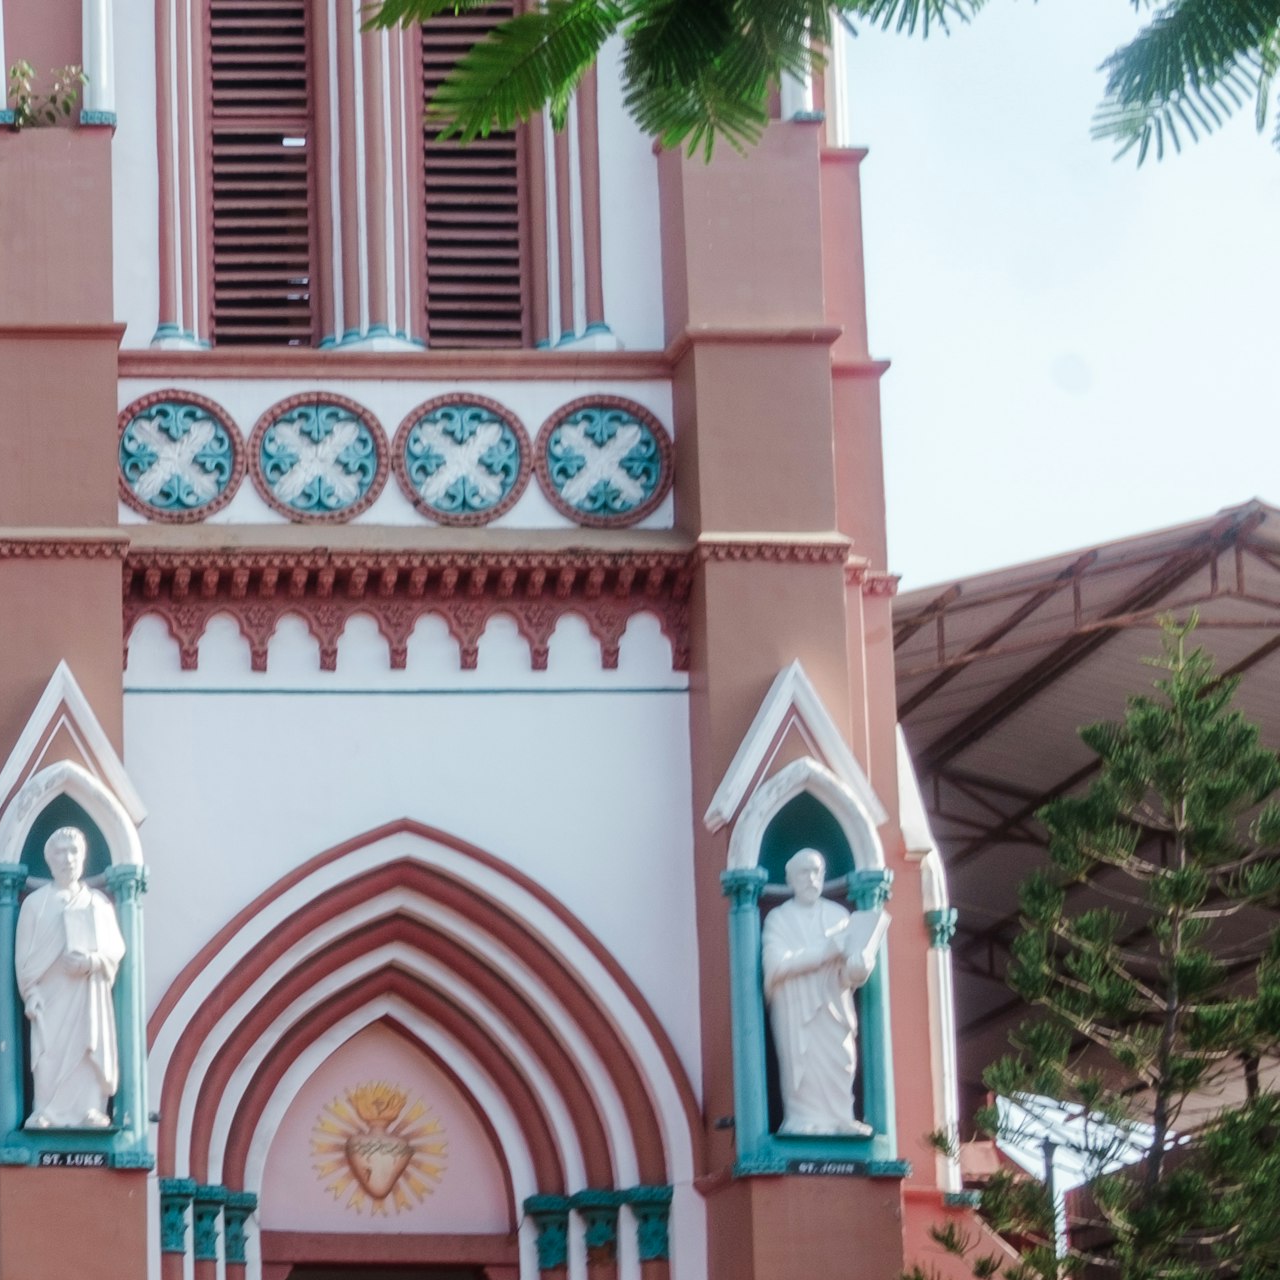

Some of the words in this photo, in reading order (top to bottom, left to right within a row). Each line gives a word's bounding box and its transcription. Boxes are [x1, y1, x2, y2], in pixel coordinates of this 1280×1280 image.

[42, 1153, 62, 1165] ST.
[65, 1153, 104, 1166] LUKE
[819, 1162, 855, 1174] JOHN
